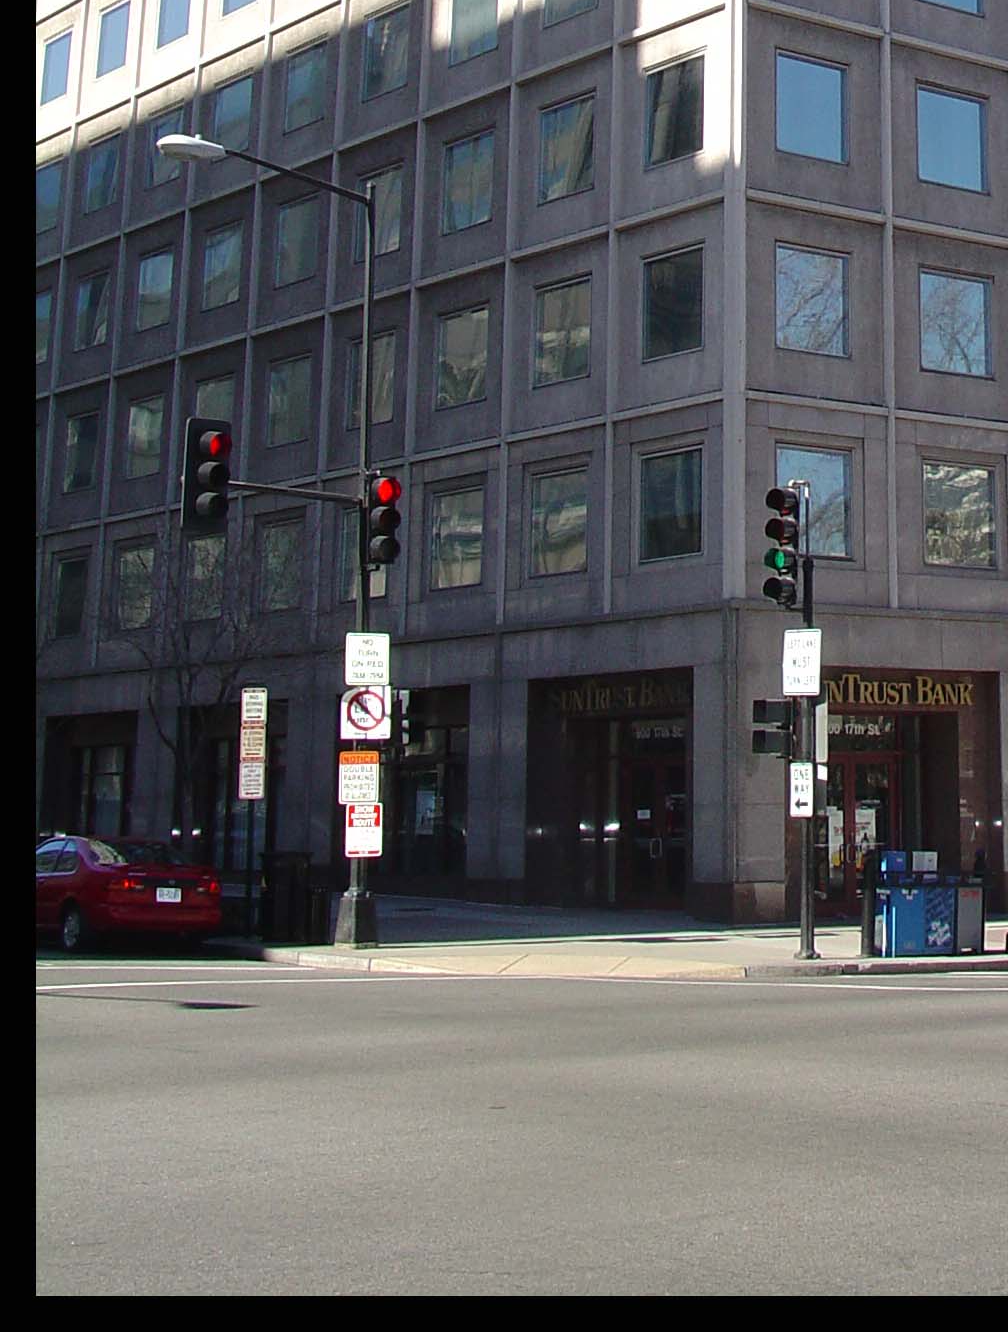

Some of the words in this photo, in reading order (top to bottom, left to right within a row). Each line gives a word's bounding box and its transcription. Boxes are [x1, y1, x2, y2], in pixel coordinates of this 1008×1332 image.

[916, 676, 974, 705] BANK
[793, 768, 810, 780] ONE
[794, 784, 810, 794] WAY
